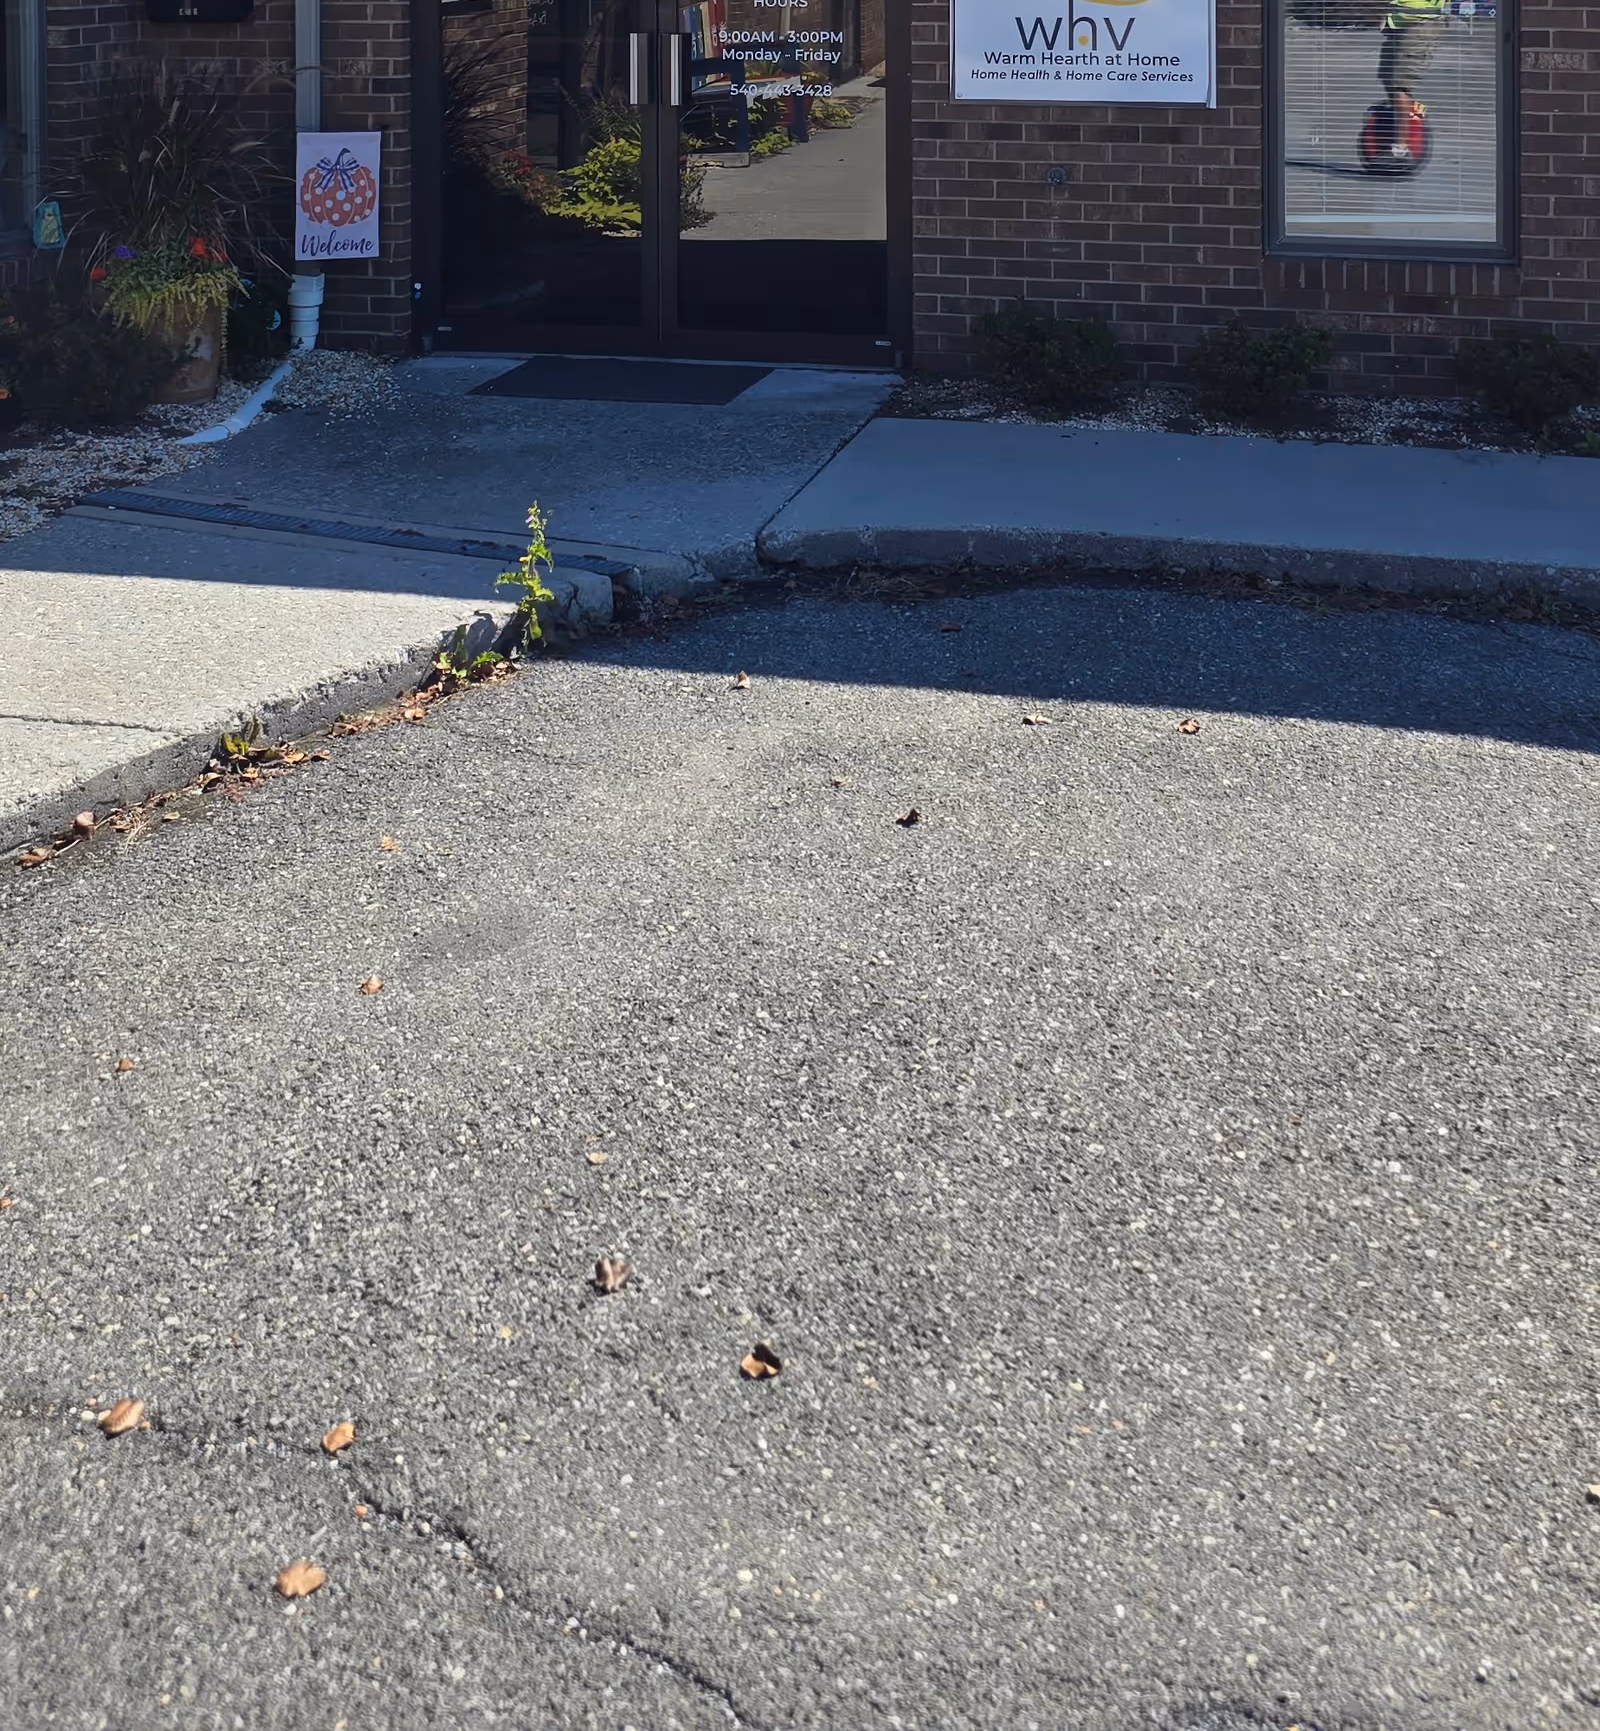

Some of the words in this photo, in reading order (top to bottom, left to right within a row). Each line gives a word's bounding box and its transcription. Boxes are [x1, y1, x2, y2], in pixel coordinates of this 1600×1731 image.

[718, 30, 775, 44] 9:00AM
[788, 30, 843, 44] 3:00PM
[722, 48, 781, 64] Monday
[795, 48, 842, 64] Friday
[983, 51, 1036, 65] Warm
[1041, 52, 1100, 66] Hearth
[1105, 54, 1122, 66] at
[1128, 53, 1181, 67] Home
[971, 69, 1007, 79] Home
[1011, 69, 1050, 80] Health
[1053, 71, 1062, 80] &
[1066, 70, 1103, 81] Home
[1107, 71, 1138, 81] Care
[1141, 71, 1194, 83] Services
[730, 84, 833, 98] 540-443-3428
[301, 229, 375, 257] Welcome
